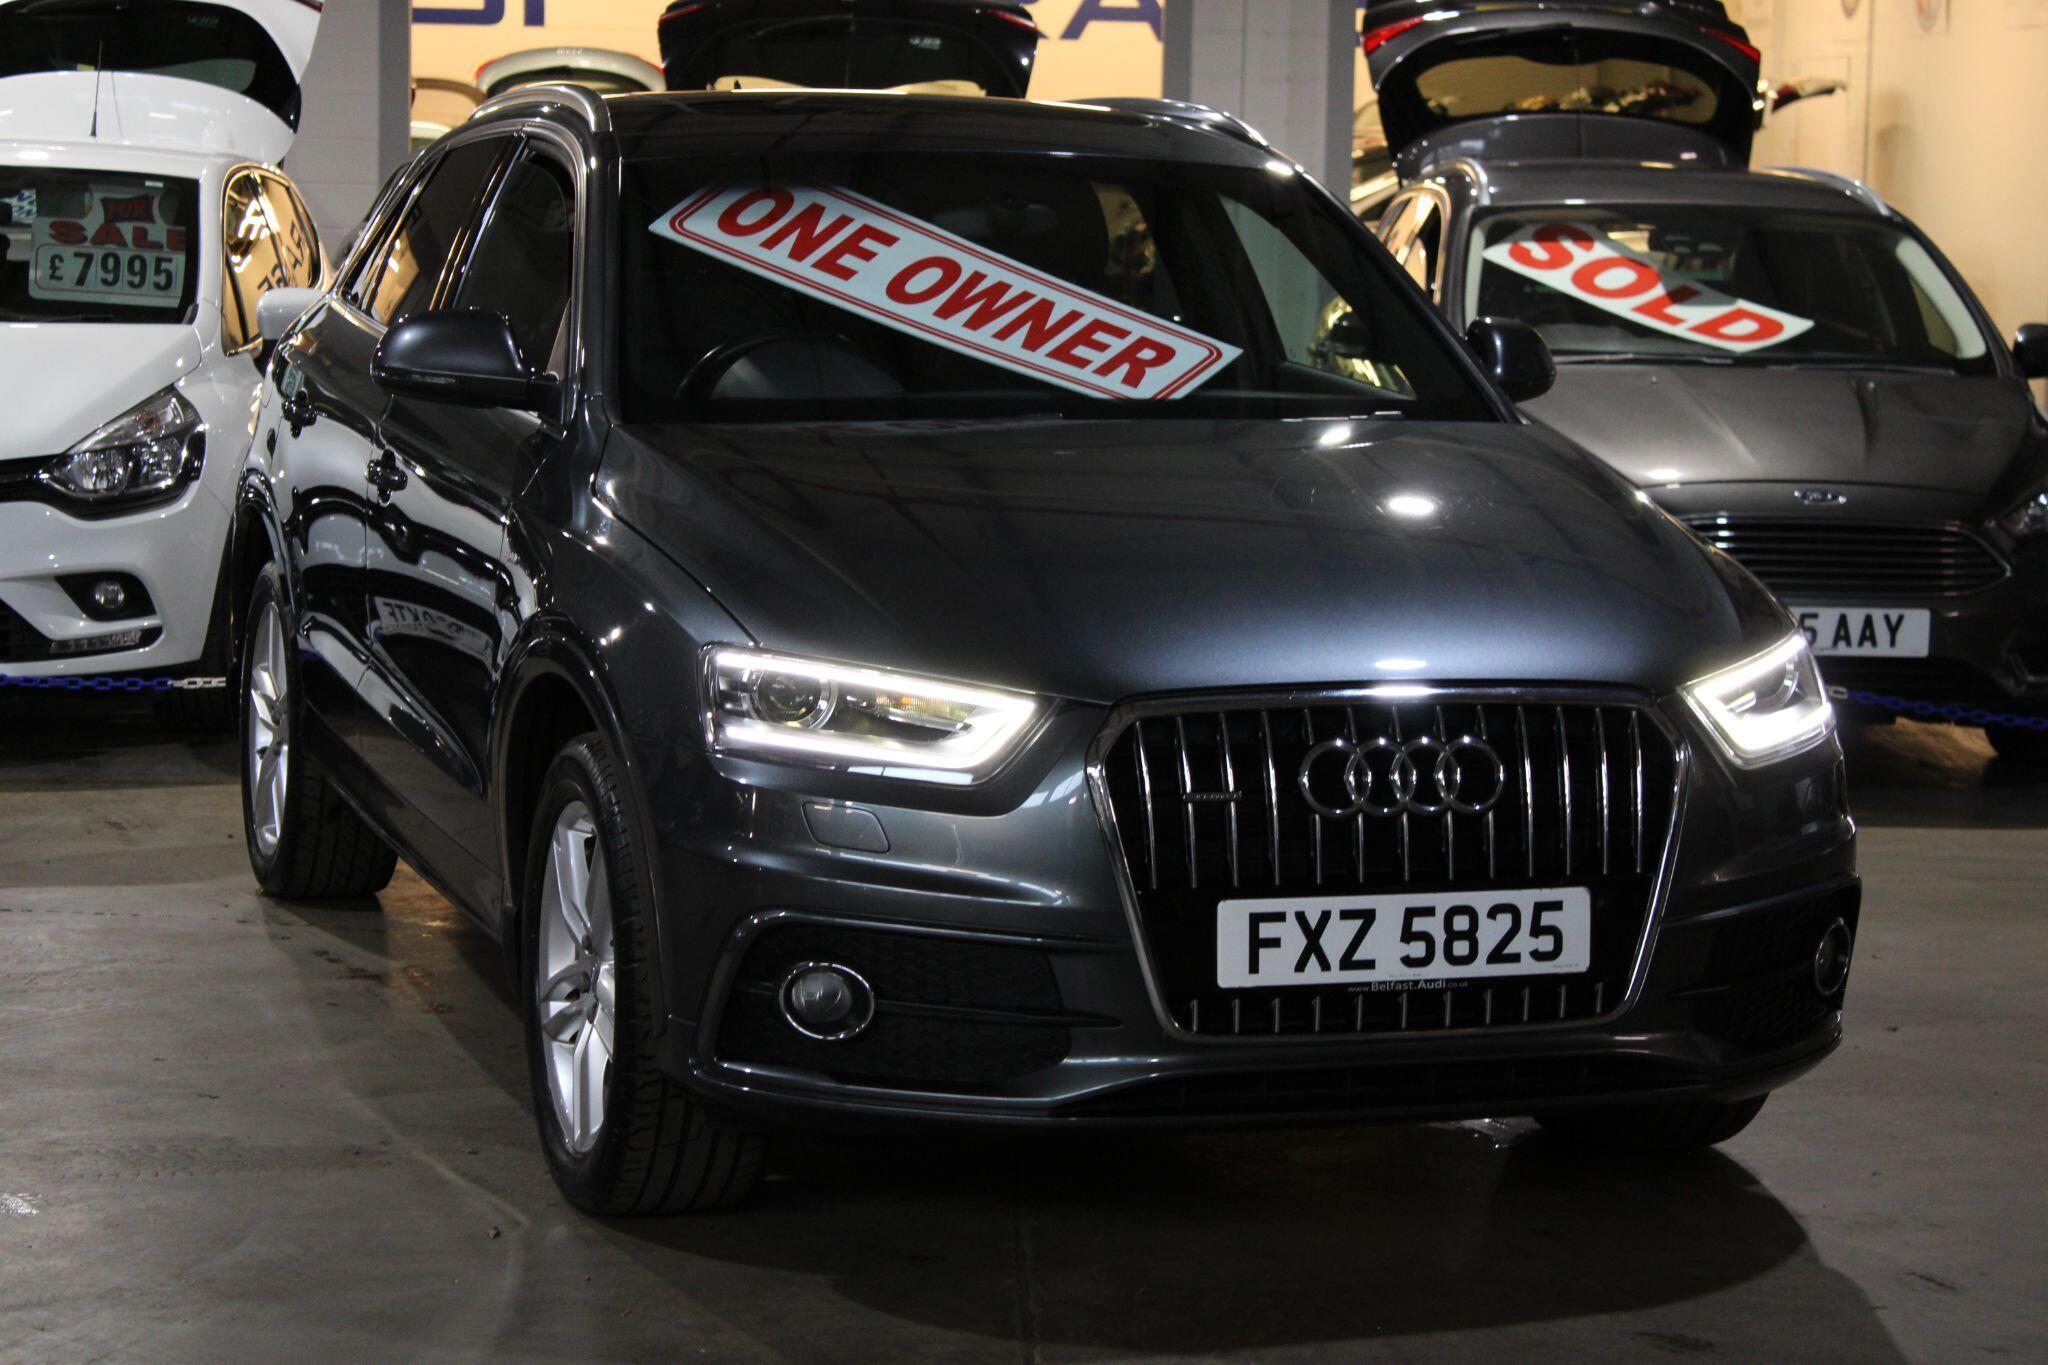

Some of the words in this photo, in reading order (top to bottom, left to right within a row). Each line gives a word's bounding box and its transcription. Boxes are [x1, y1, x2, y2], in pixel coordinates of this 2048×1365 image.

[49, 220, 187, 251] SALE
[49, 252, 173, 291] £7995
[716, 186, 899, 281] ONE
[885, 256, 1176, 389] OWNER
[1508, 224, 1784, 343] SOLD
[1832, 613, 1904, 648] AAY
[1248, 908, 1377, 975] FXZ
[1400, 900, 1563, 968] 5825
